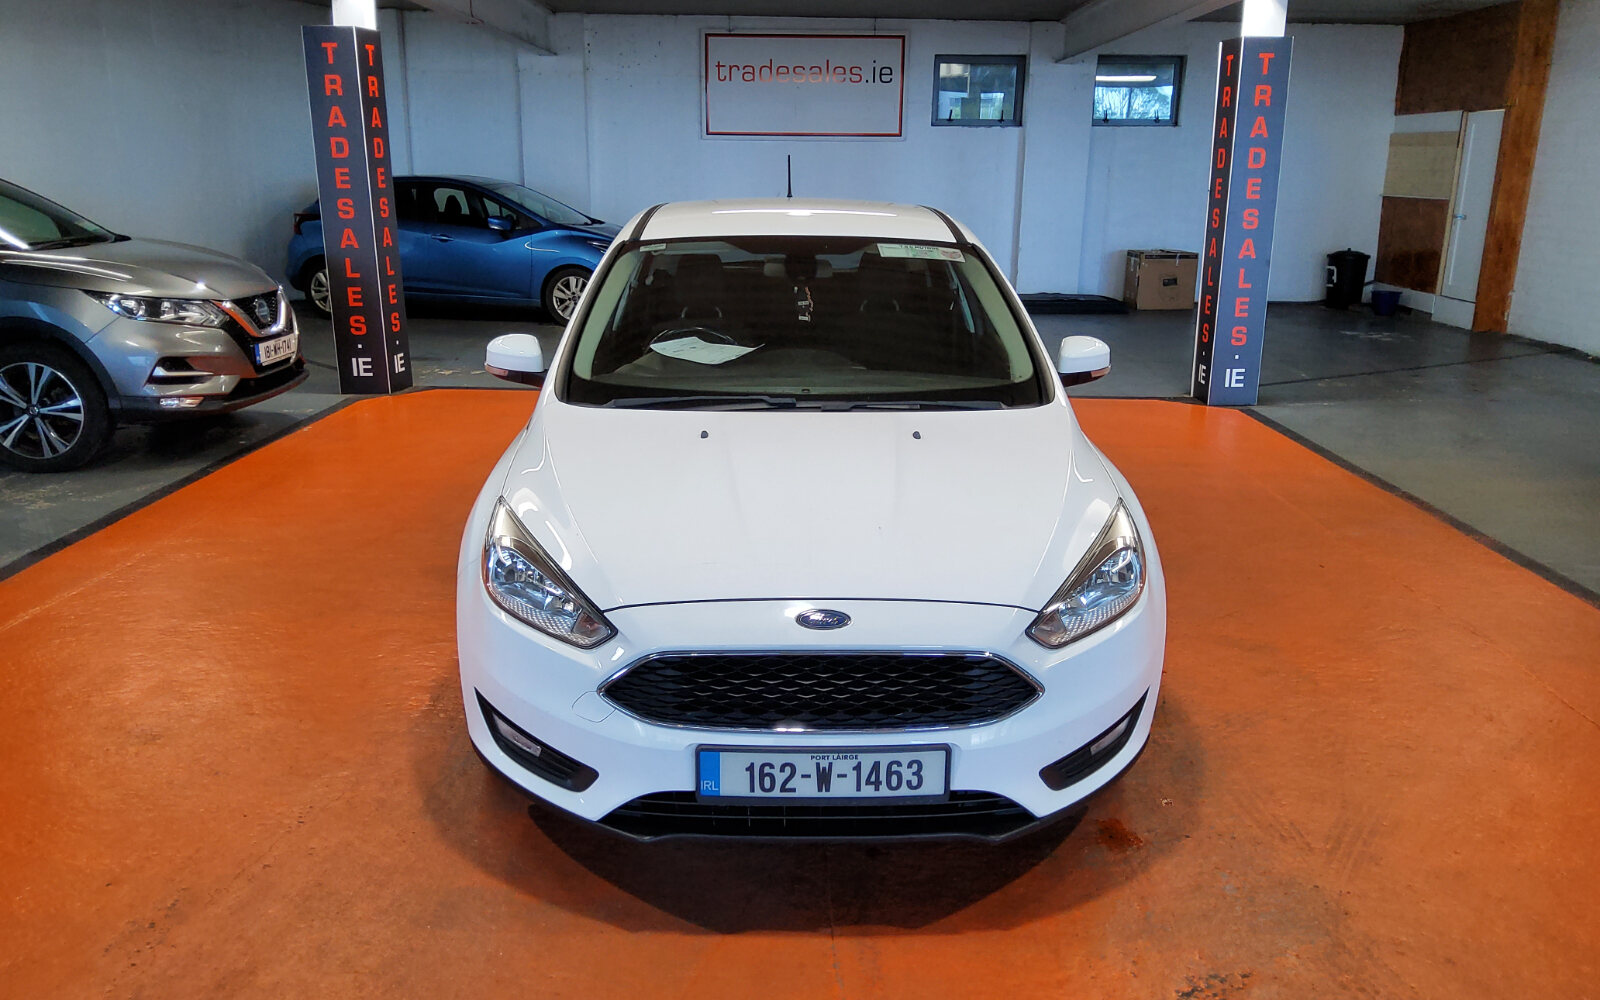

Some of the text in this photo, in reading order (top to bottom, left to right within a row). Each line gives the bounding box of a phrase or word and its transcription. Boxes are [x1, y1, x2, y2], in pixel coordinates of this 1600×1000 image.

[321, 42, 374, 377] TRADESALES.IE
[364, 44, 406, 373] TRADESALES.IE
[715, 58, 893, 84] tradesales.ie
[1198, 54, 1235, 384] TRADESALES.IE
[1225, 52, 1275, 388] TRADESALES.IE
[700, 780, 719, 791] IRL
[744, 760, 923, 792] 162-W-1463
